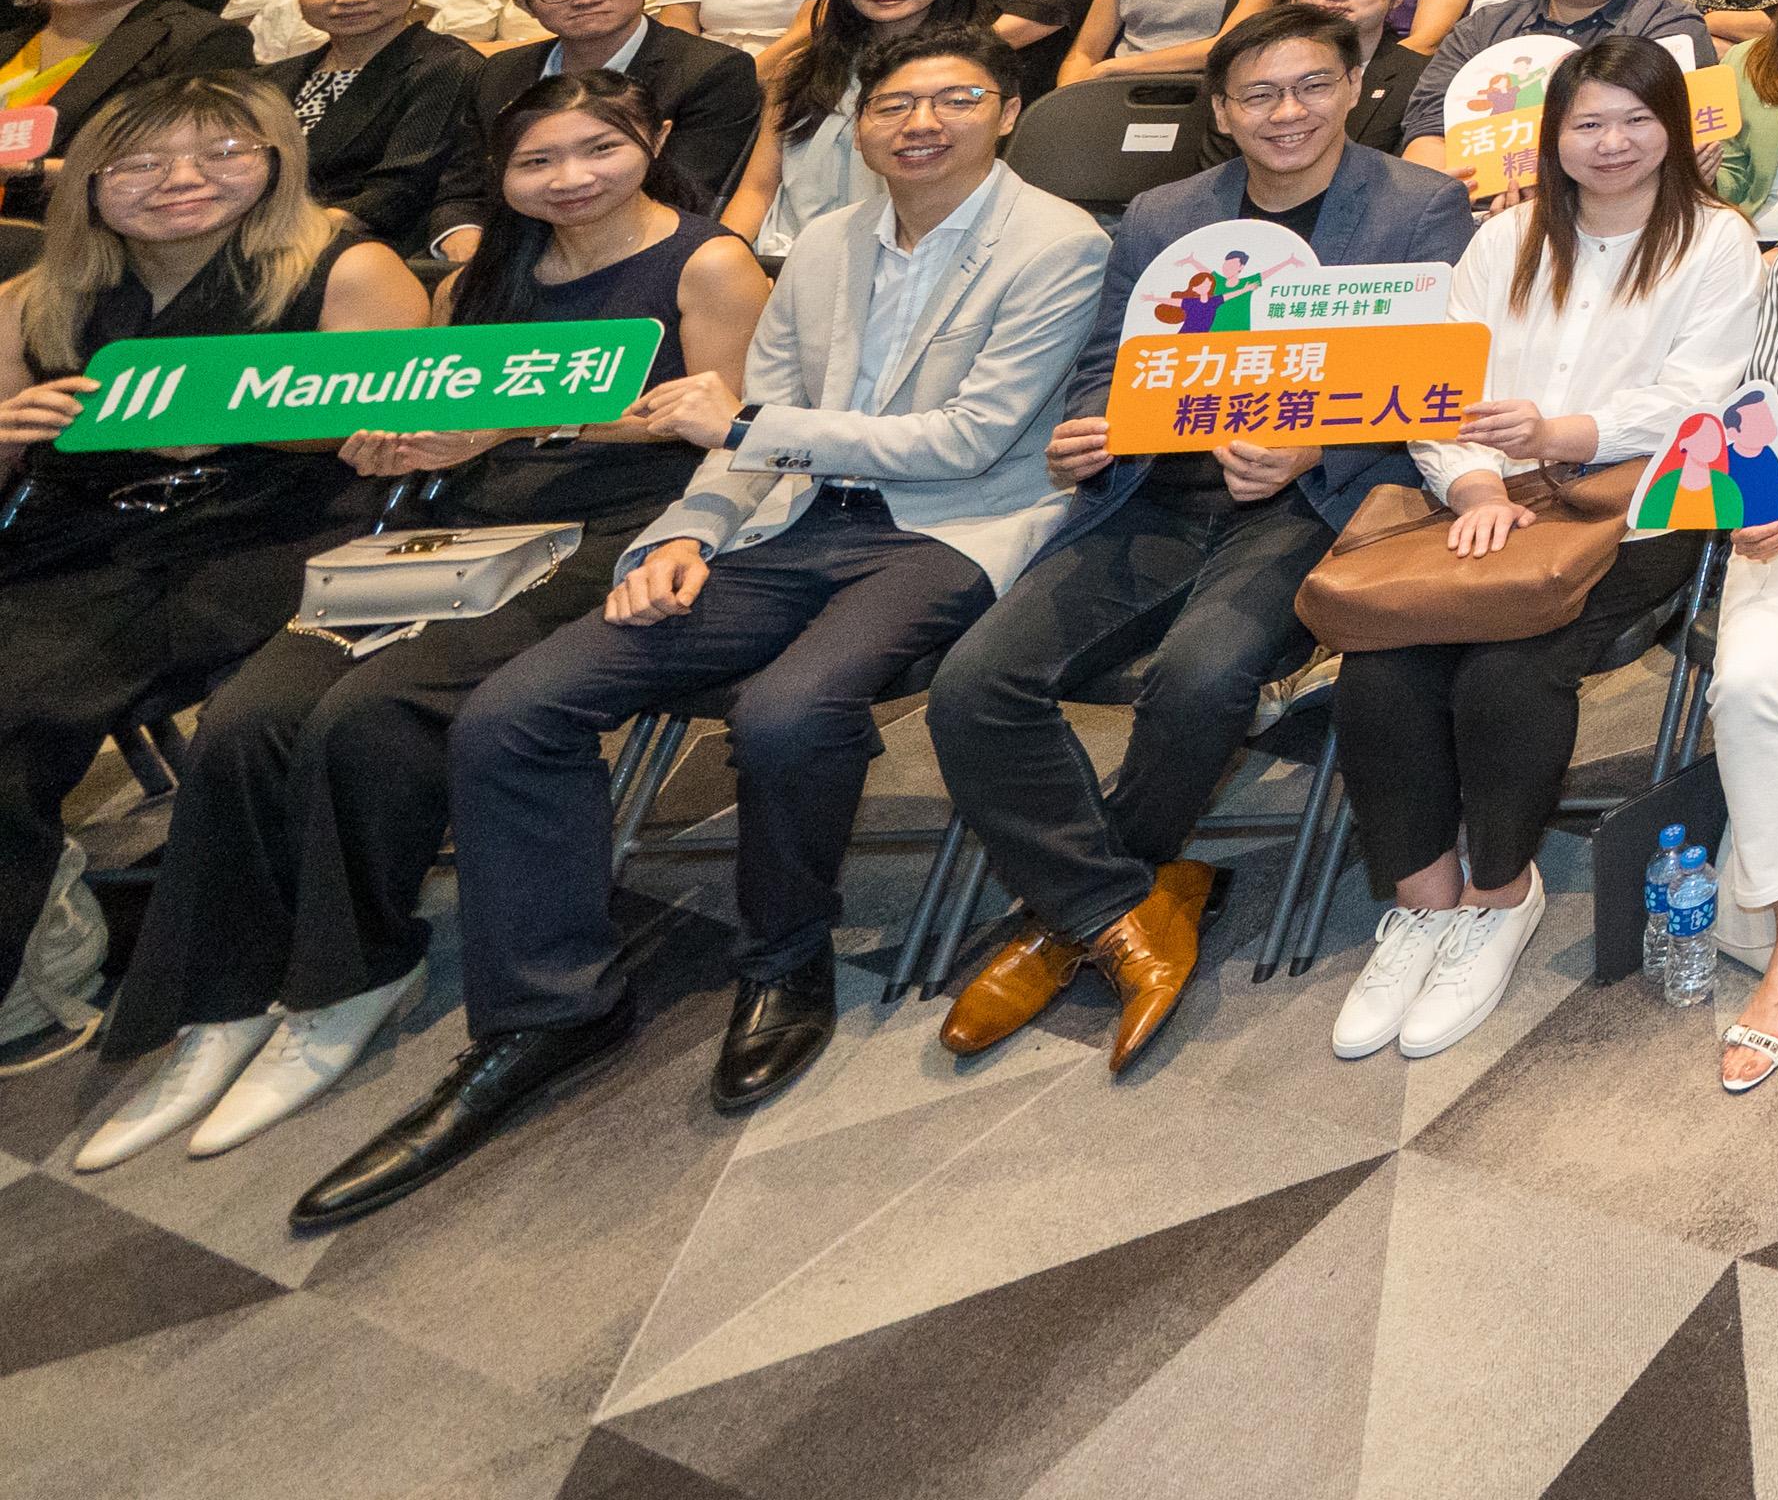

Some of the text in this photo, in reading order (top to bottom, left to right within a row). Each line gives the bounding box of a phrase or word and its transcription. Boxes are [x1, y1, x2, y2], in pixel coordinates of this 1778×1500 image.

[1266, 298, 1392, 320] 職場提升計劃
[1270, 282, 1331, 298] FUTURE
[226, 346, 627, 410] Manulife 宏利
[1131, 342, 1328, 390] 活力再現
[1172, 381, 1464, 436] 精彩第二人生
